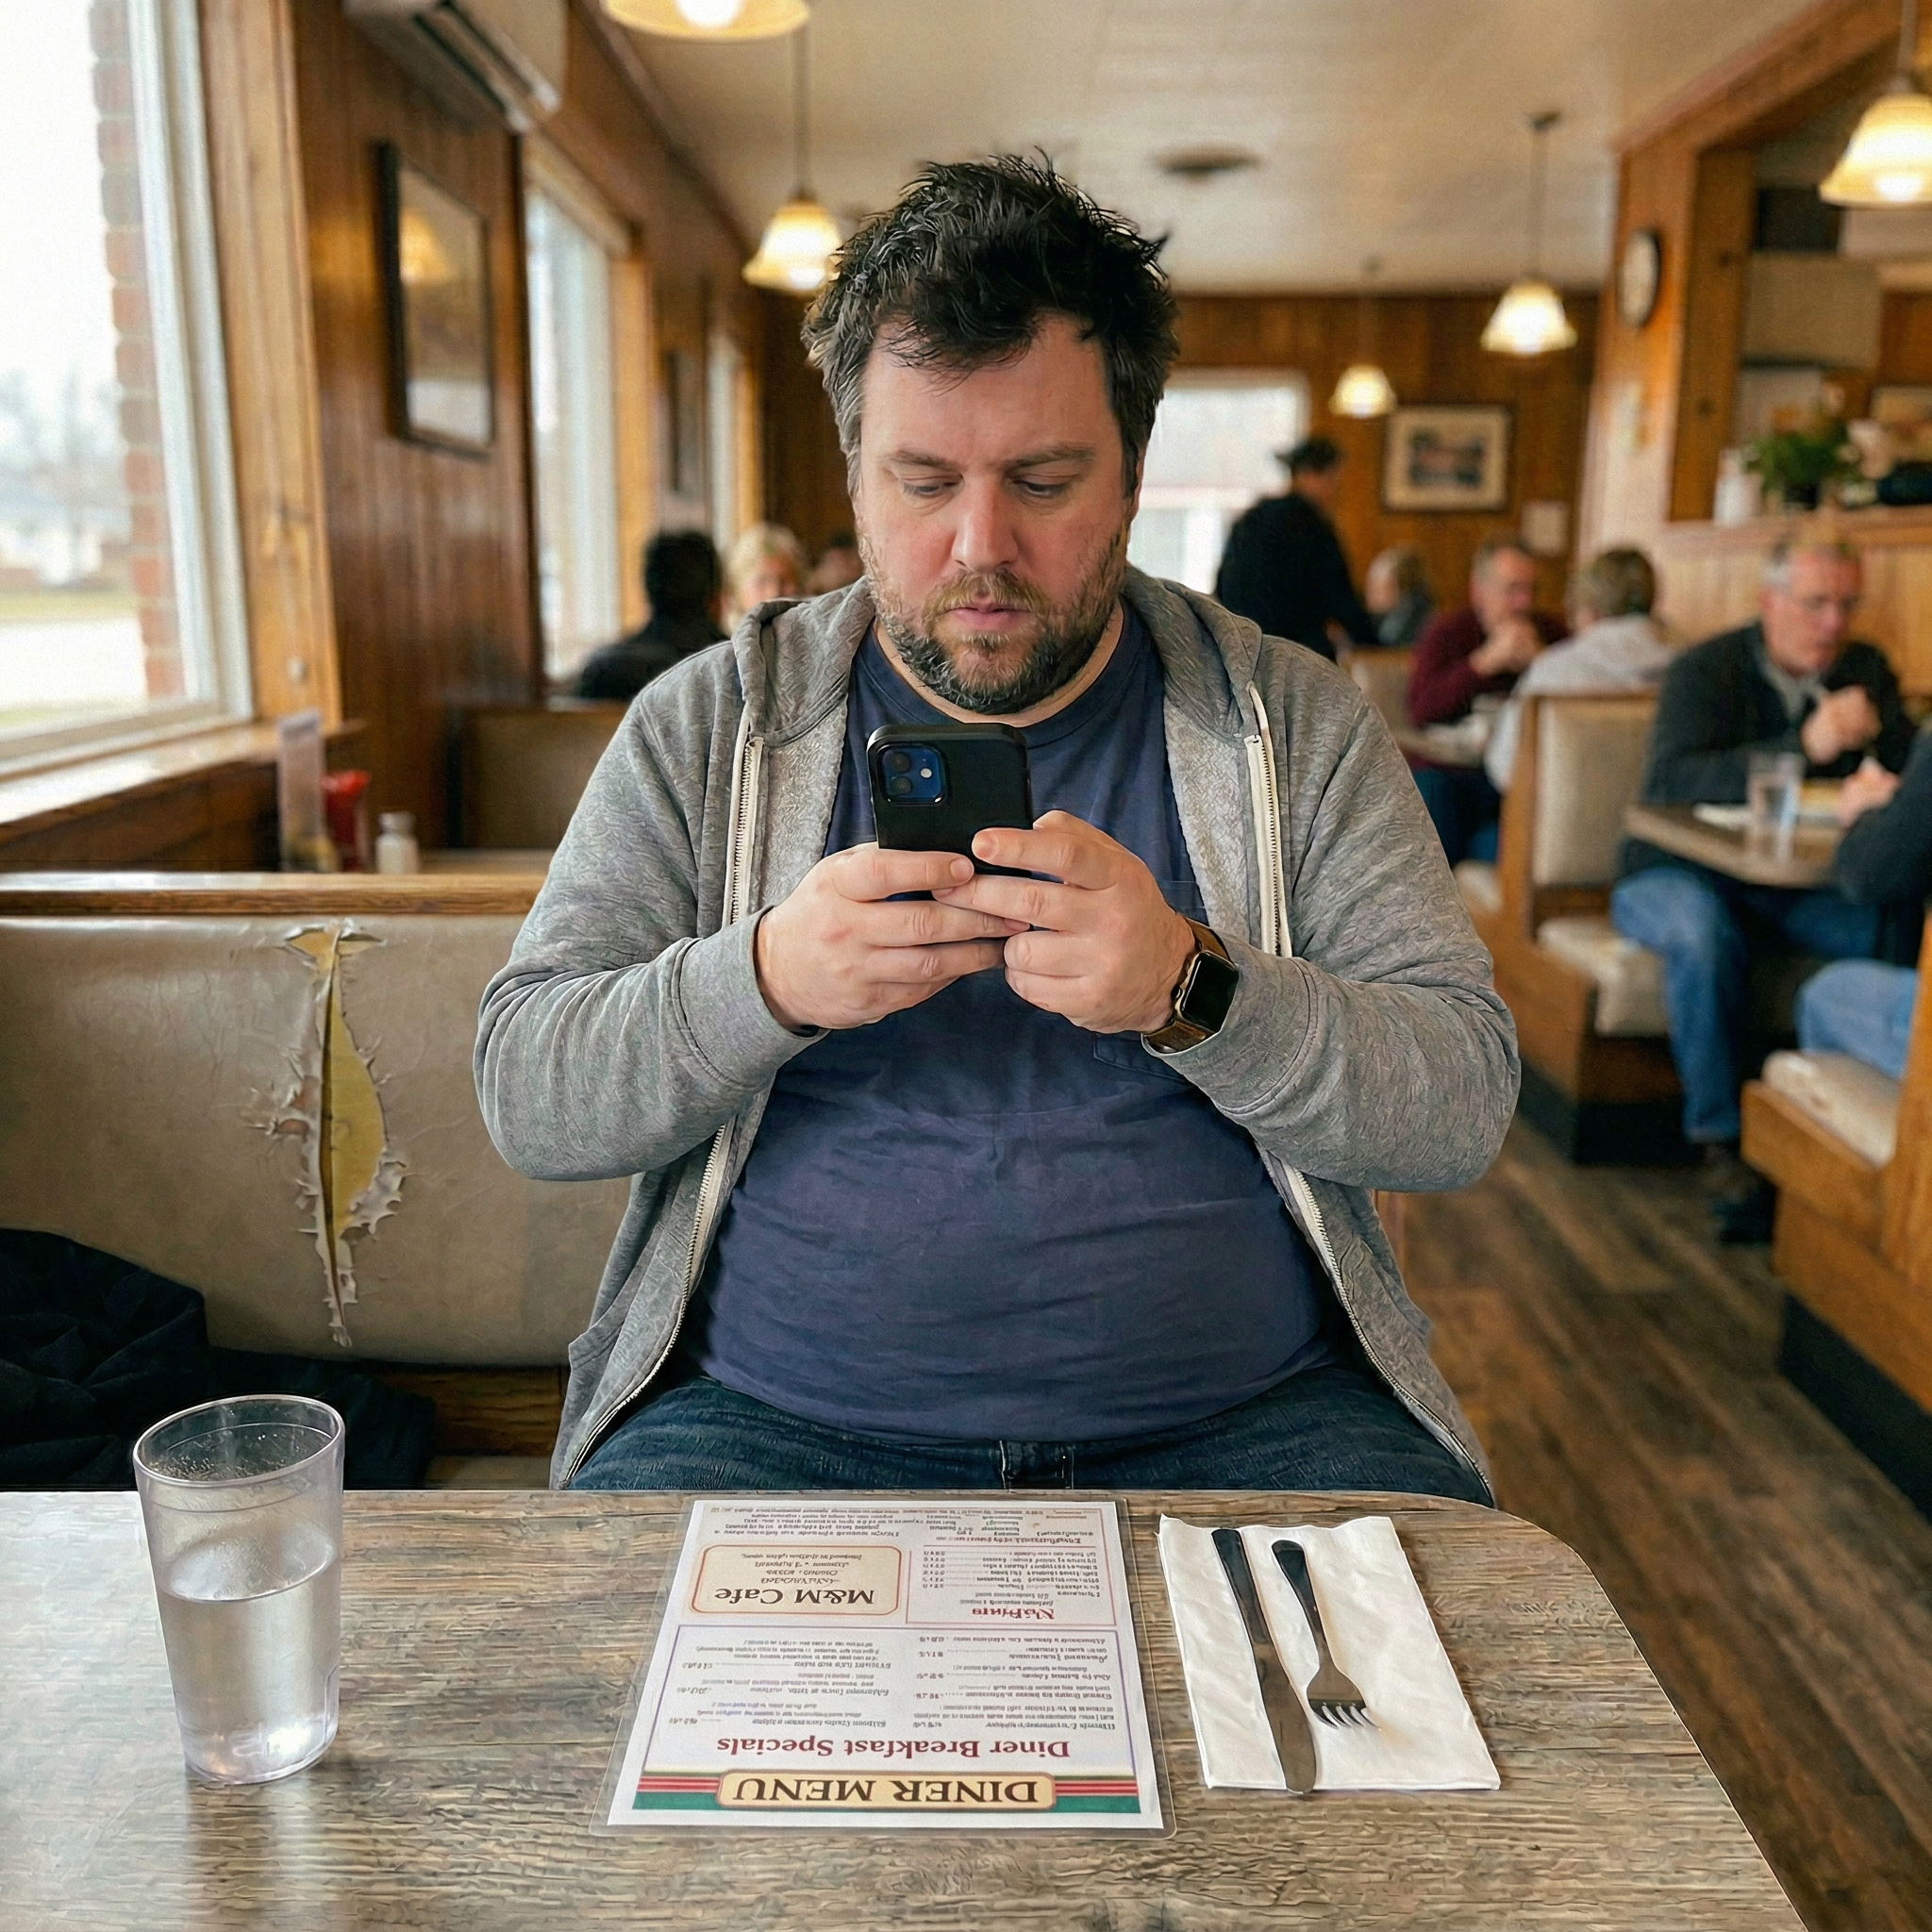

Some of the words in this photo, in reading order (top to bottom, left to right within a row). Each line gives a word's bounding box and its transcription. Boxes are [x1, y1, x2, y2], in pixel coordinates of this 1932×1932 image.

[715, 1589, 784, 1605] Cafe
[794, 1589, 874, 1605] M&M
[717, 1736, 834, 1757] Specials
[843, 1739, 981, 1759] Breakfast
[988, 1740, 1071, 1758] Diner
[732, 1778, 876, 1802] MENU
[892, 1779, 1040, 1804] DINER
